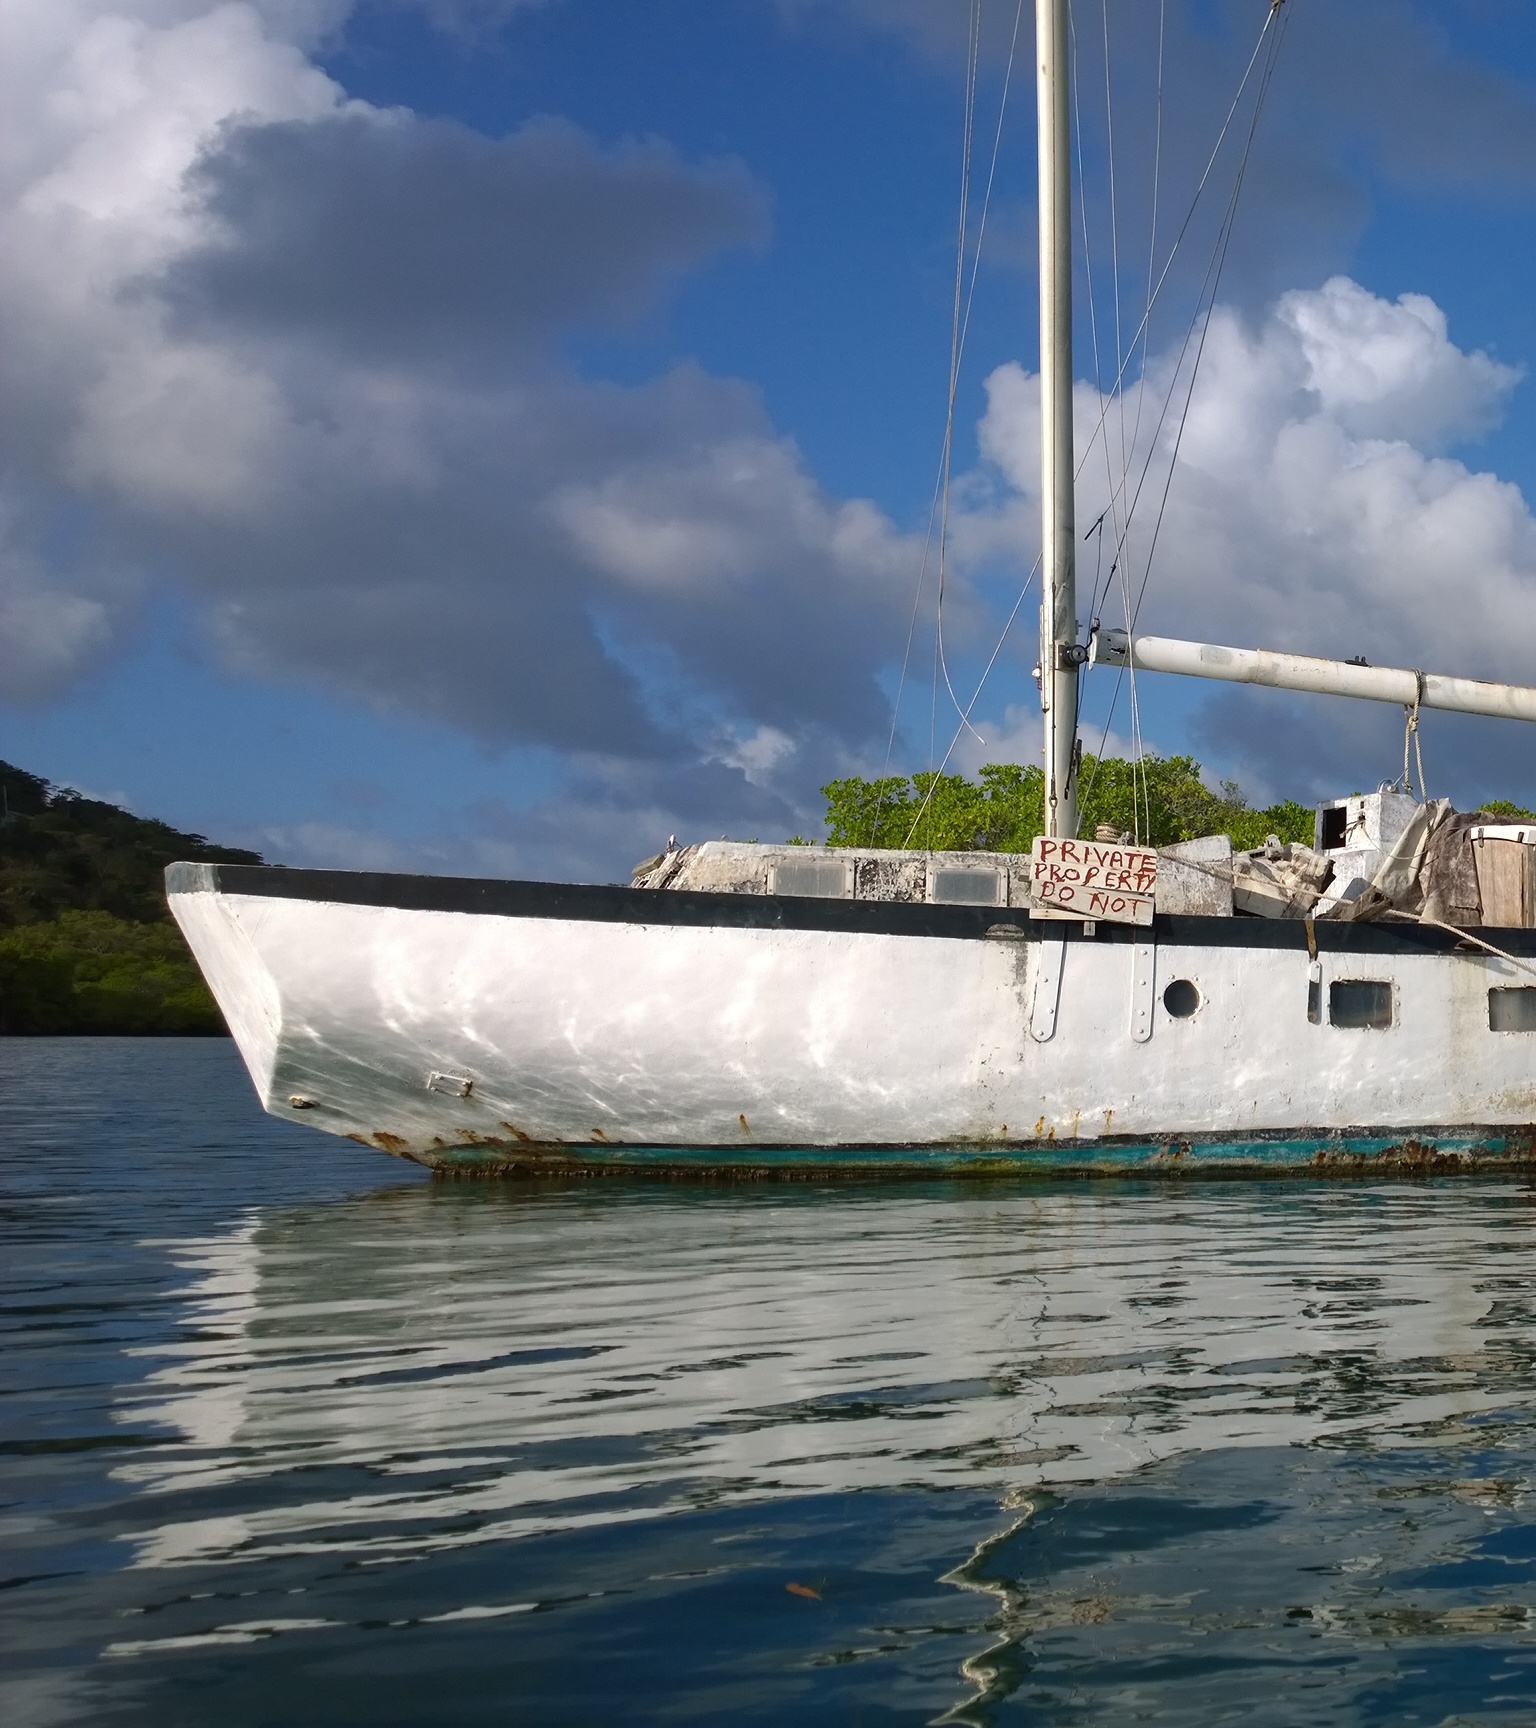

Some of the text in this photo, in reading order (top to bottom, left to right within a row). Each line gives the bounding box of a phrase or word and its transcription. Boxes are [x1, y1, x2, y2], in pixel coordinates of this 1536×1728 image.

[1040, 840, 1156, 872] PRIVATE
[1035, 863, 1156, 892] PROPERTY
[1040, 881, 1151, 916] DO NOT
